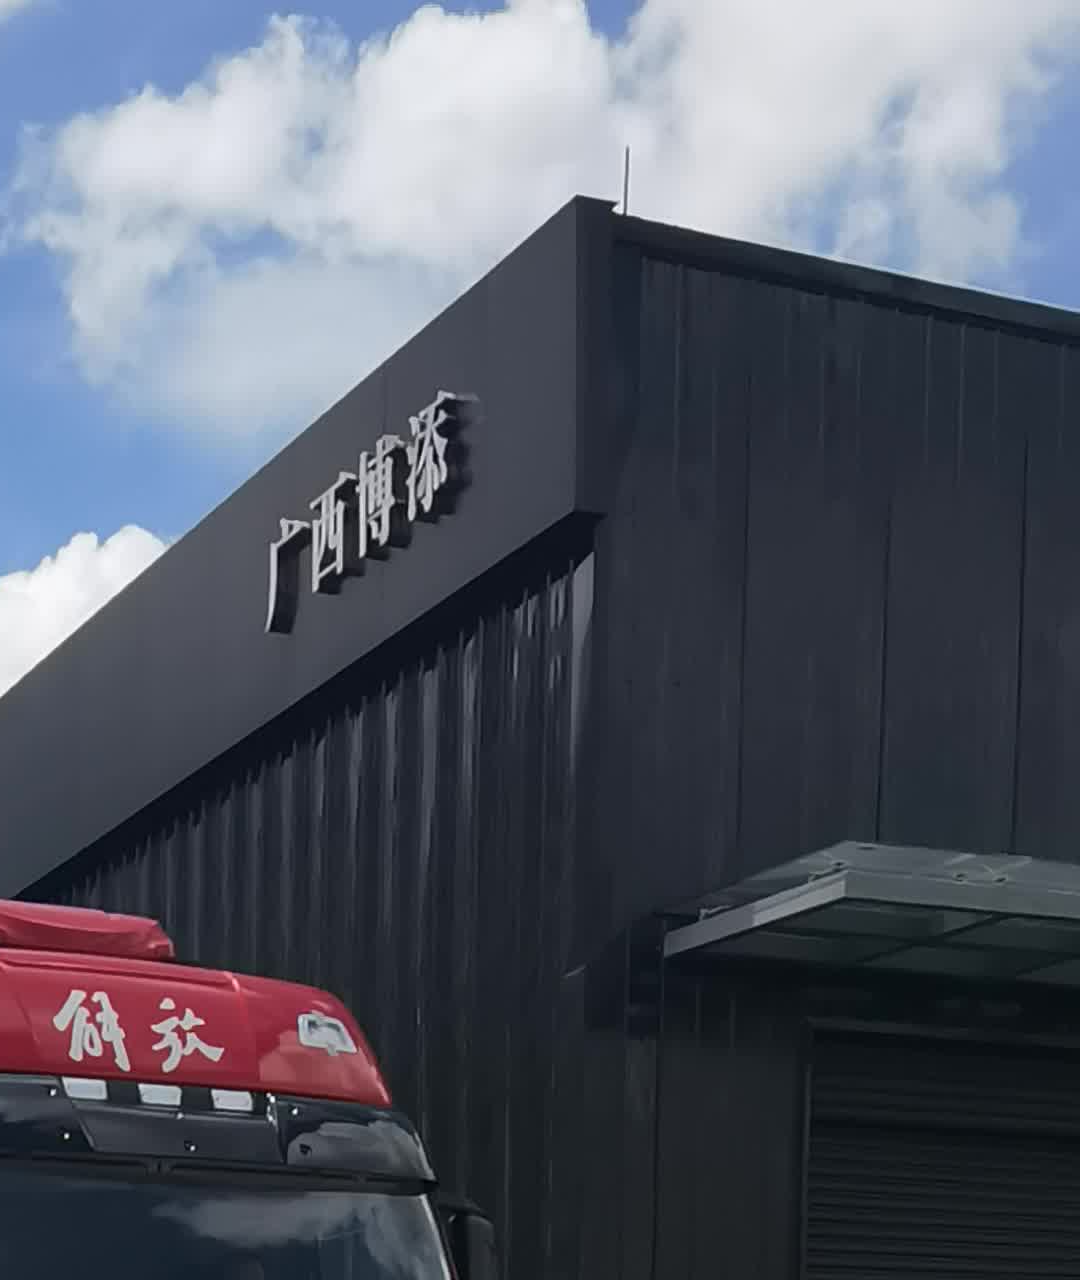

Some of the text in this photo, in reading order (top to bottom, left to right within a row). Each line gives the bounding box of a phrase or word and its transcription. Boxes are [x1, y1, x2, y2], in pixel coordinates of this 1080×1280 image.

[265, 389, 457, 634] 广西博添
[52, 989, 225, 1072] 解放
